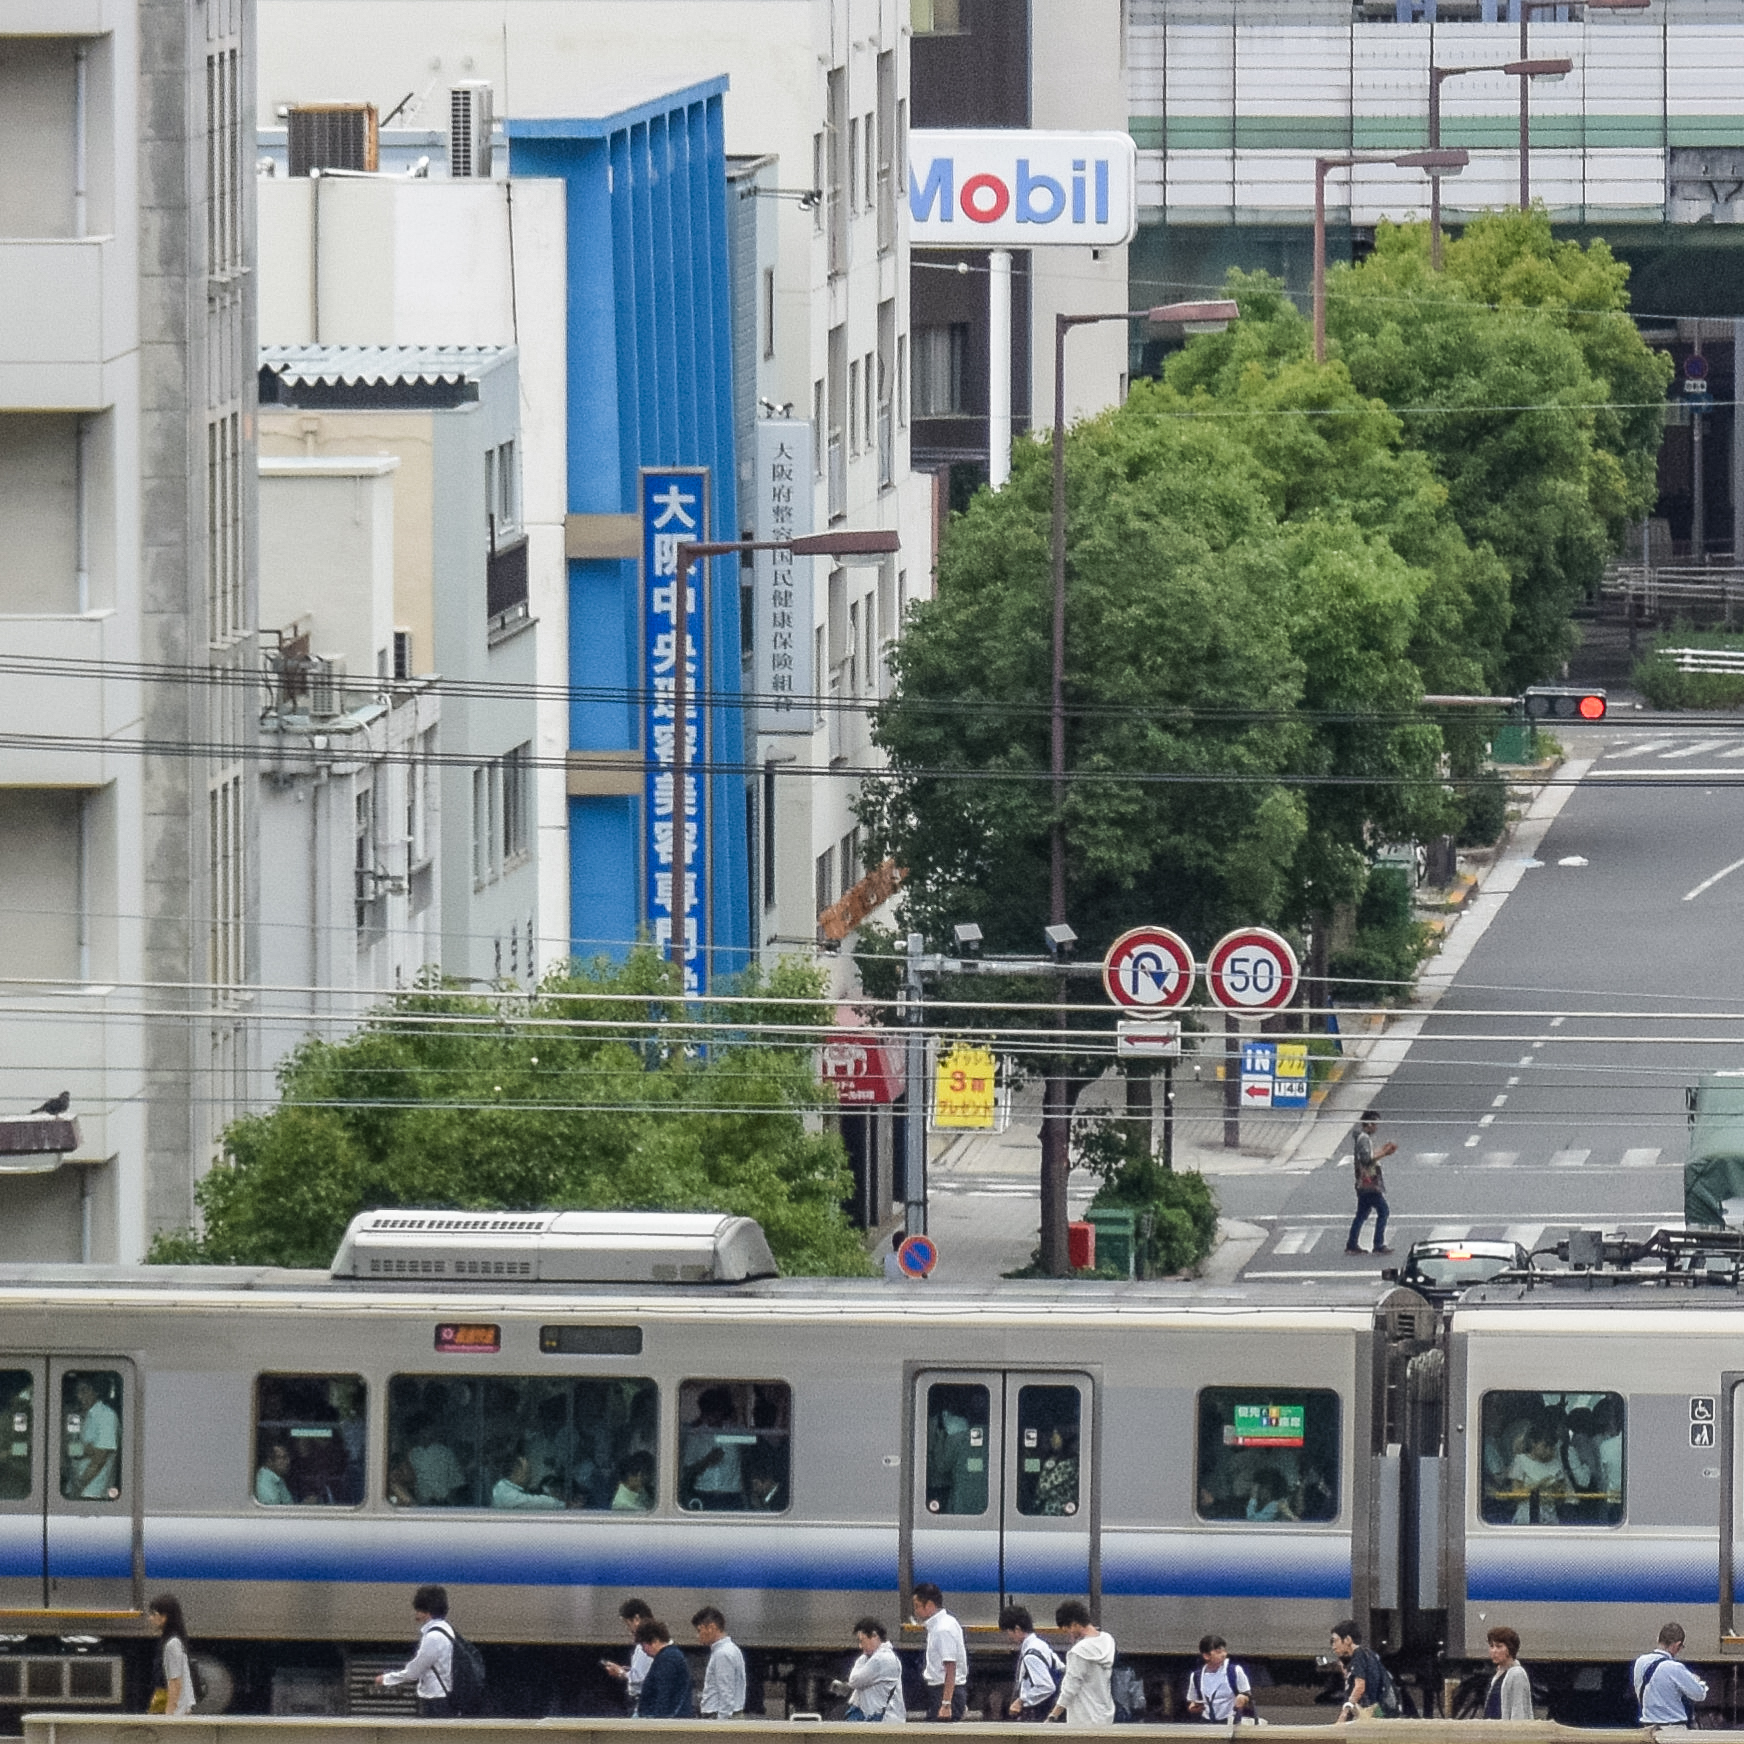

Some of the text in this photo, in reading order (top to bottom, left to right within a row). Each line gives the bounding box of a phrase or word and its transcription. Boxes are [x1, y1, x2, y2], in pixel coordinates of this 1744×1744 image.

[911, 158, 1109, 225] Mobil
[1230, 957, 1274, 993] 50
[1246, 1048, 1271, 1071] IN
